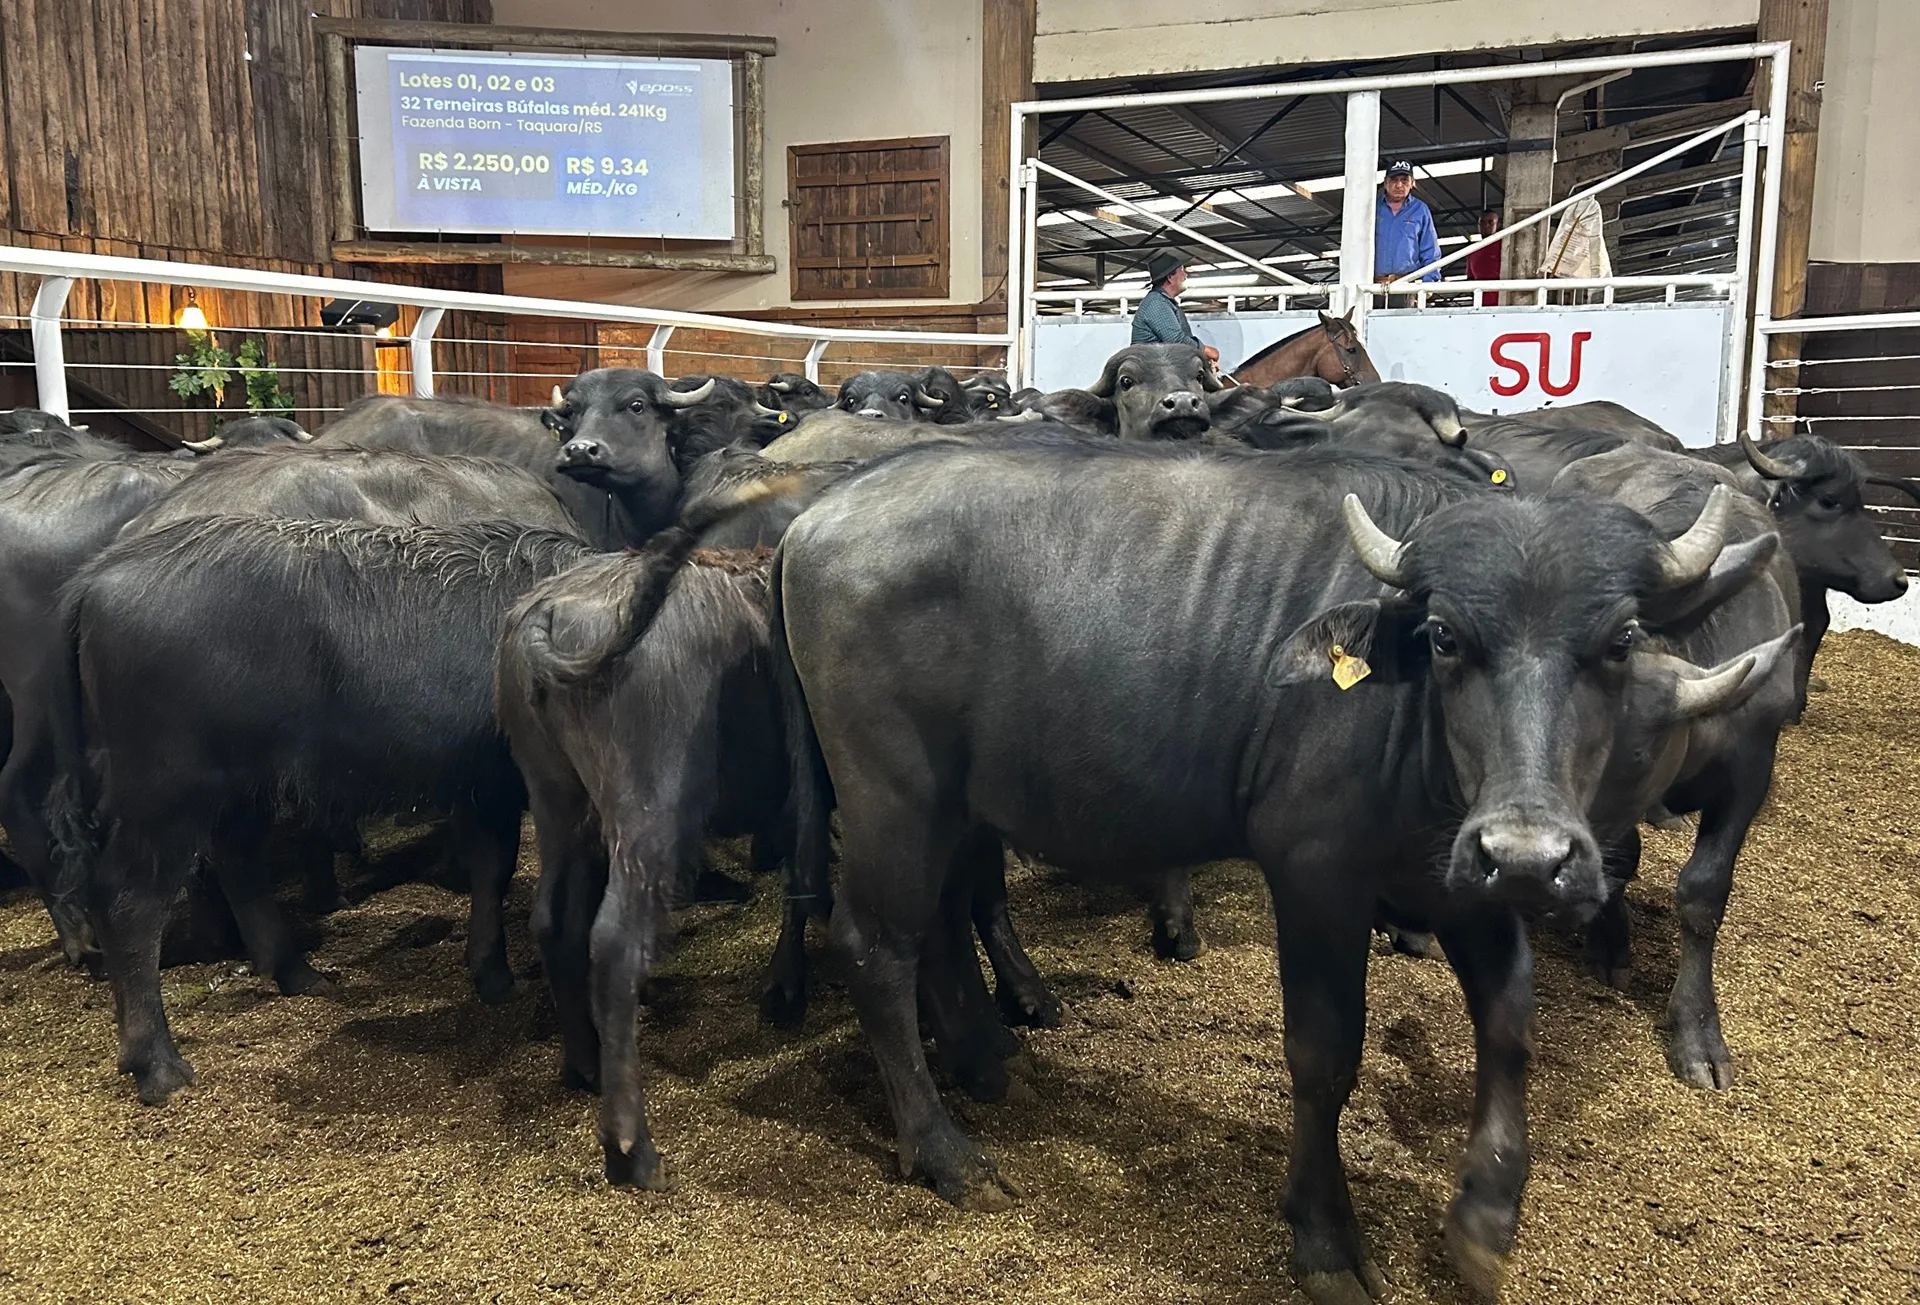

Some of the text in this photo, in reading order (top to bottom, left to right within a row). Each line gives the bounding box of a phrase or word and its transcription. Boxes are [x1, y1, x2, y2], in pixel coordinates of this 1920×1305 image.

[400, 72, 555, 92] Lotes 01, 02 e 03
[401, 96, 667, 121] 32 Terneiras Búfalas méd. 241Kg
[402, 116, 464, 129] Fazenda
[469, 118, 501, 130] Born
[517, 119, 602, 135] Taquara/RS
[419, 152, 549, 175] R$ 2.250,00
[567, 156, 648, 176] R$ 9.34
[417, 175, 482, 191] À VISTA
[567, 179, 638, 197] MÉD./KG
[1490, 332, 1591, 397] SU
